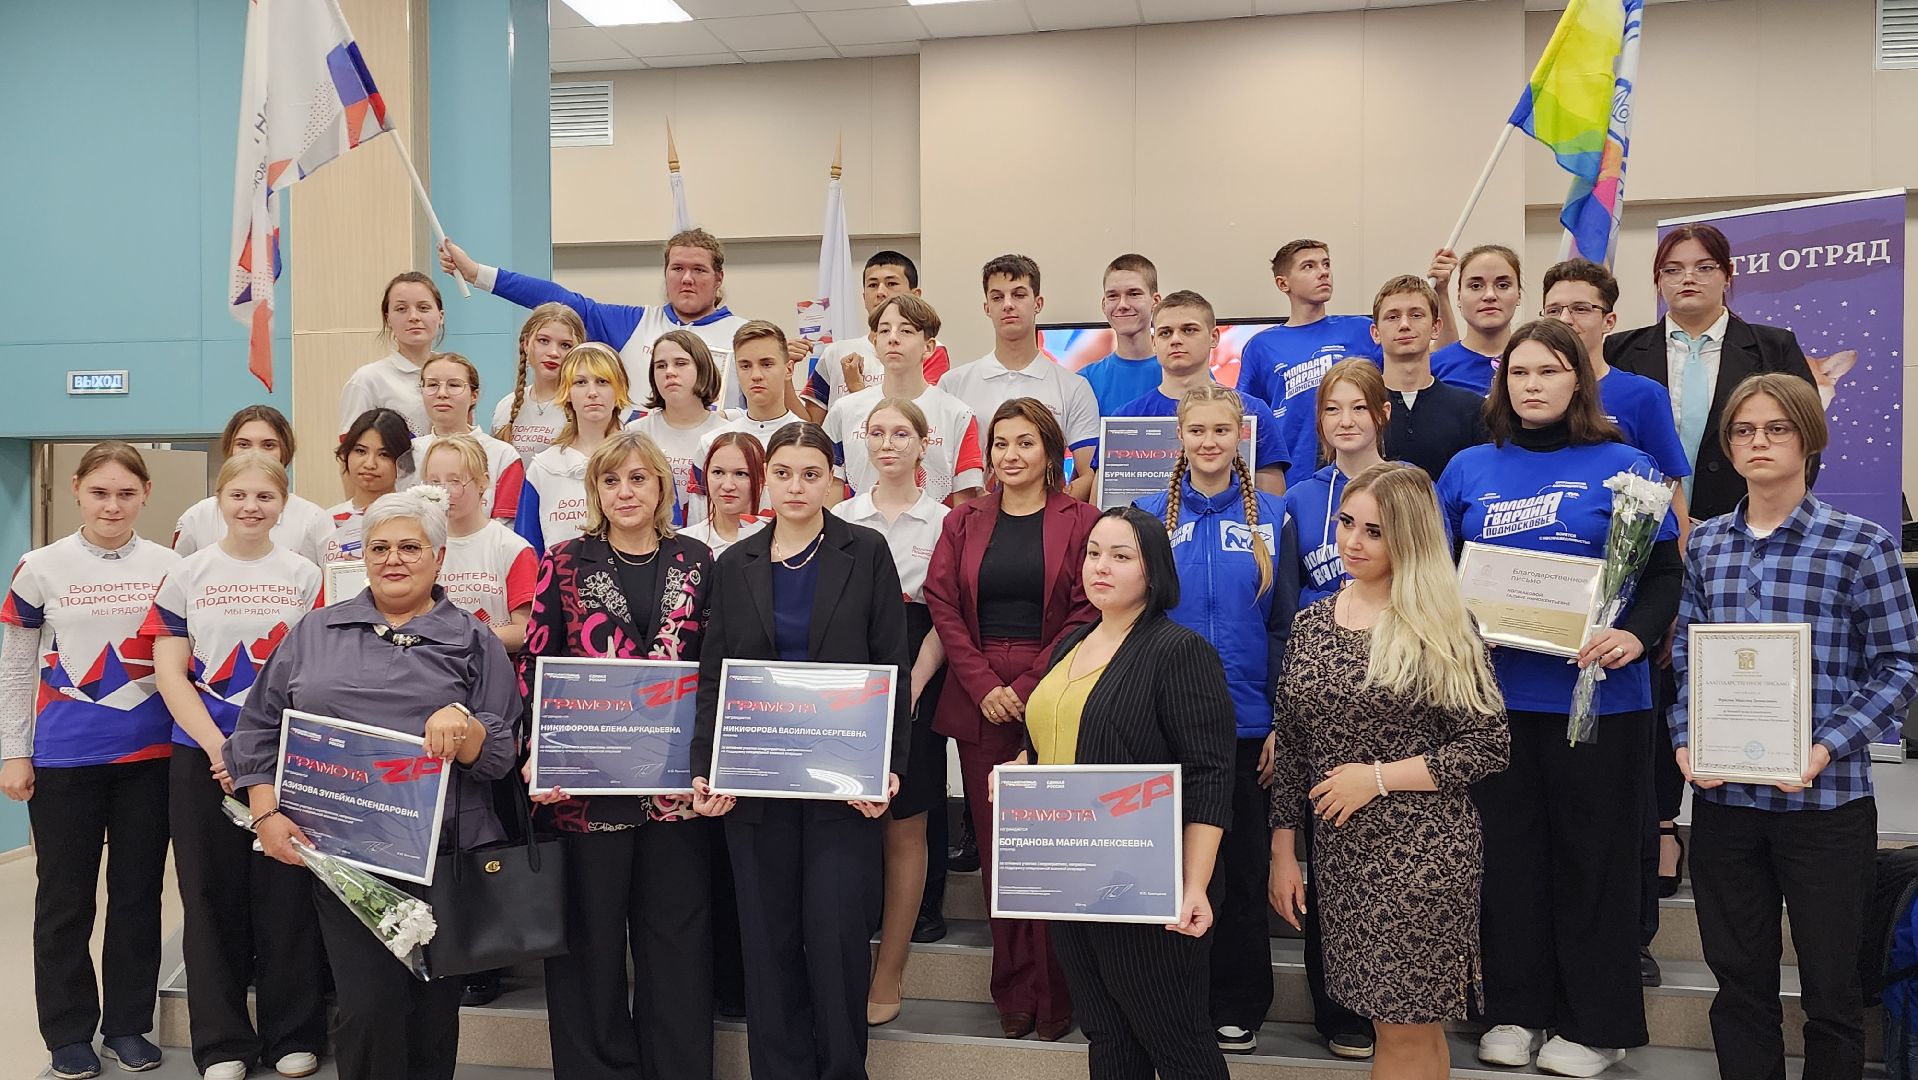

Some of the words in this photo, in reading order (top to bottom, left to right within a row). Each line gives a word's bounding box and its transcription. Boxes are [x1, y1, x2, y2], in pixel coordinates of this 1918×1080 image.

[1778, 239, 1891, 271] ОТРЯД
[74, 375, 122, 388] ВЫХОД
[1485, 515, 1553, 537] ПОДМОСКОВЬЕ
[205, 584, 297, 596] ВОЛОНТЕРЫ
[196, 595, 305, 610] ПОДМОСКОВЬЯ
[112, 606, 148, 616] РЯДОМ
[224, 608, 241, 616] МЫ
[244, 608, 280, 617] РЯДОМ
[542, 698, 634, 712] ГРАМОТА
[727, 699, 817, 714] ГРАМОТА
[540, 724, 600, 733] НИКИФОРОВА
[600, 725, 628, 733] ЕЛЕНА
[628, 726, 681, 735] АРКАДЬЕВНА
[723, 725, 778, 734] НИКИФОРОВА
[779, 727, 822, 736] ВАСИЛИСА
[822, 729, 867, 738] СЕРГЕЕВНА
[286, 753, 369, 784] ГРАМОТА
[282, 779, 319, 798] АЗИЗОВА
[318, 788, 356, 805] ЗУЛЕЙХА
[356, 798, 420, 819] СКЕНДАРОВНА
[1001, 808, 1097, 822] ГРАМОТА
[999, 837, 1054, 847] БОГДАНОВА
[1055, 838, 1089, 847] МАРИЯ
[1091, 839, 1154, 848] АЛЕКСЕЕВНА
